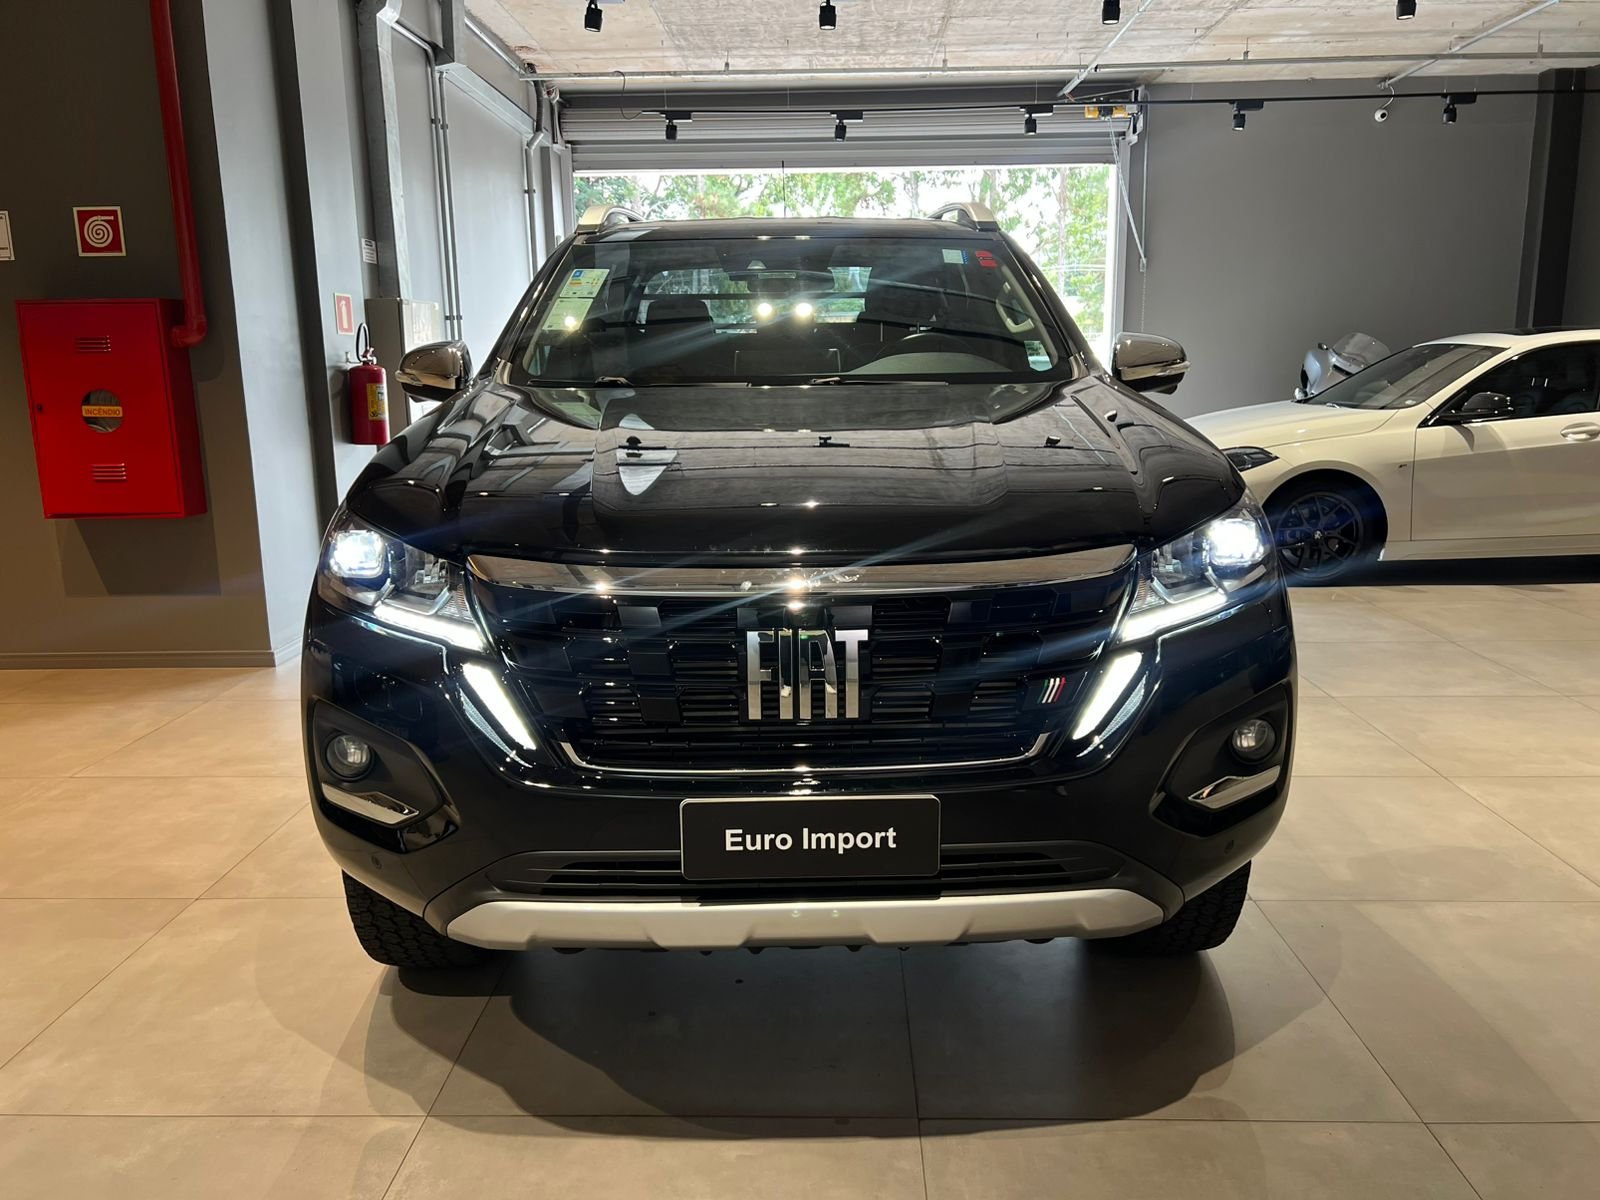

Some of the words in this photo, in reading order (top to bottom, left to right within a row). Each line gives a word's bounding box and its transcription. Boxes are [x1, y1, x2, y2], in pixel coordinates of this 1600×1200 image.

[747, 629, 868, 719] FIAT
[725, 829, 793, 851] Euro
[802, 827, 897, 854] Import
